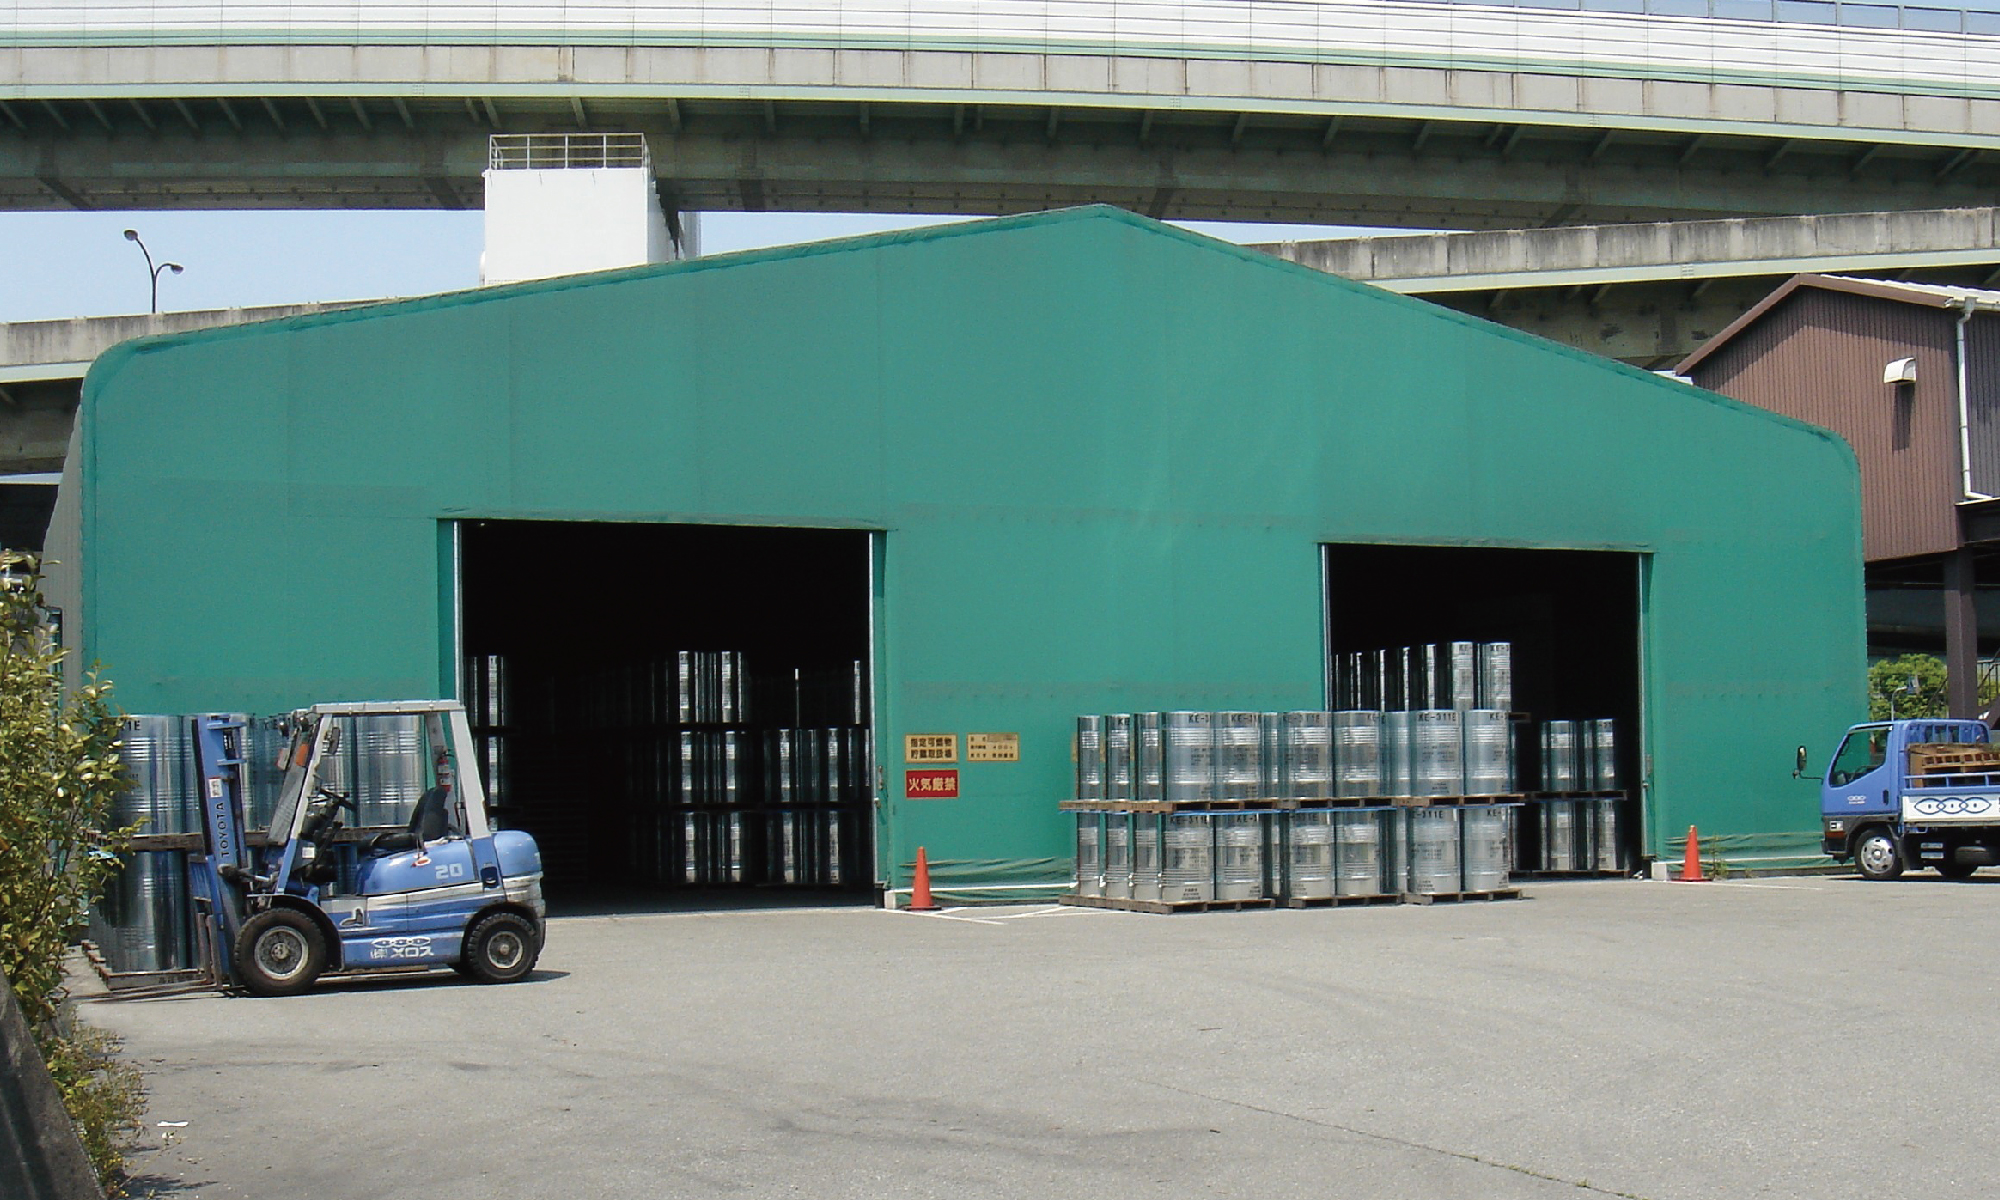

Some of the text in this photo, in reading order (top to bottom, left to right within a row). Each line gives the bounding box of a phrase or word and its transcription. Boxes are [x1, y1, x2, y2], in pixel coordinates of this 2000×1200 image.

[908, 777, 956, 792] 火気厳禁
[216, 802, 230, 858] TOYOTA
[435, 862, 464, 880] 20
